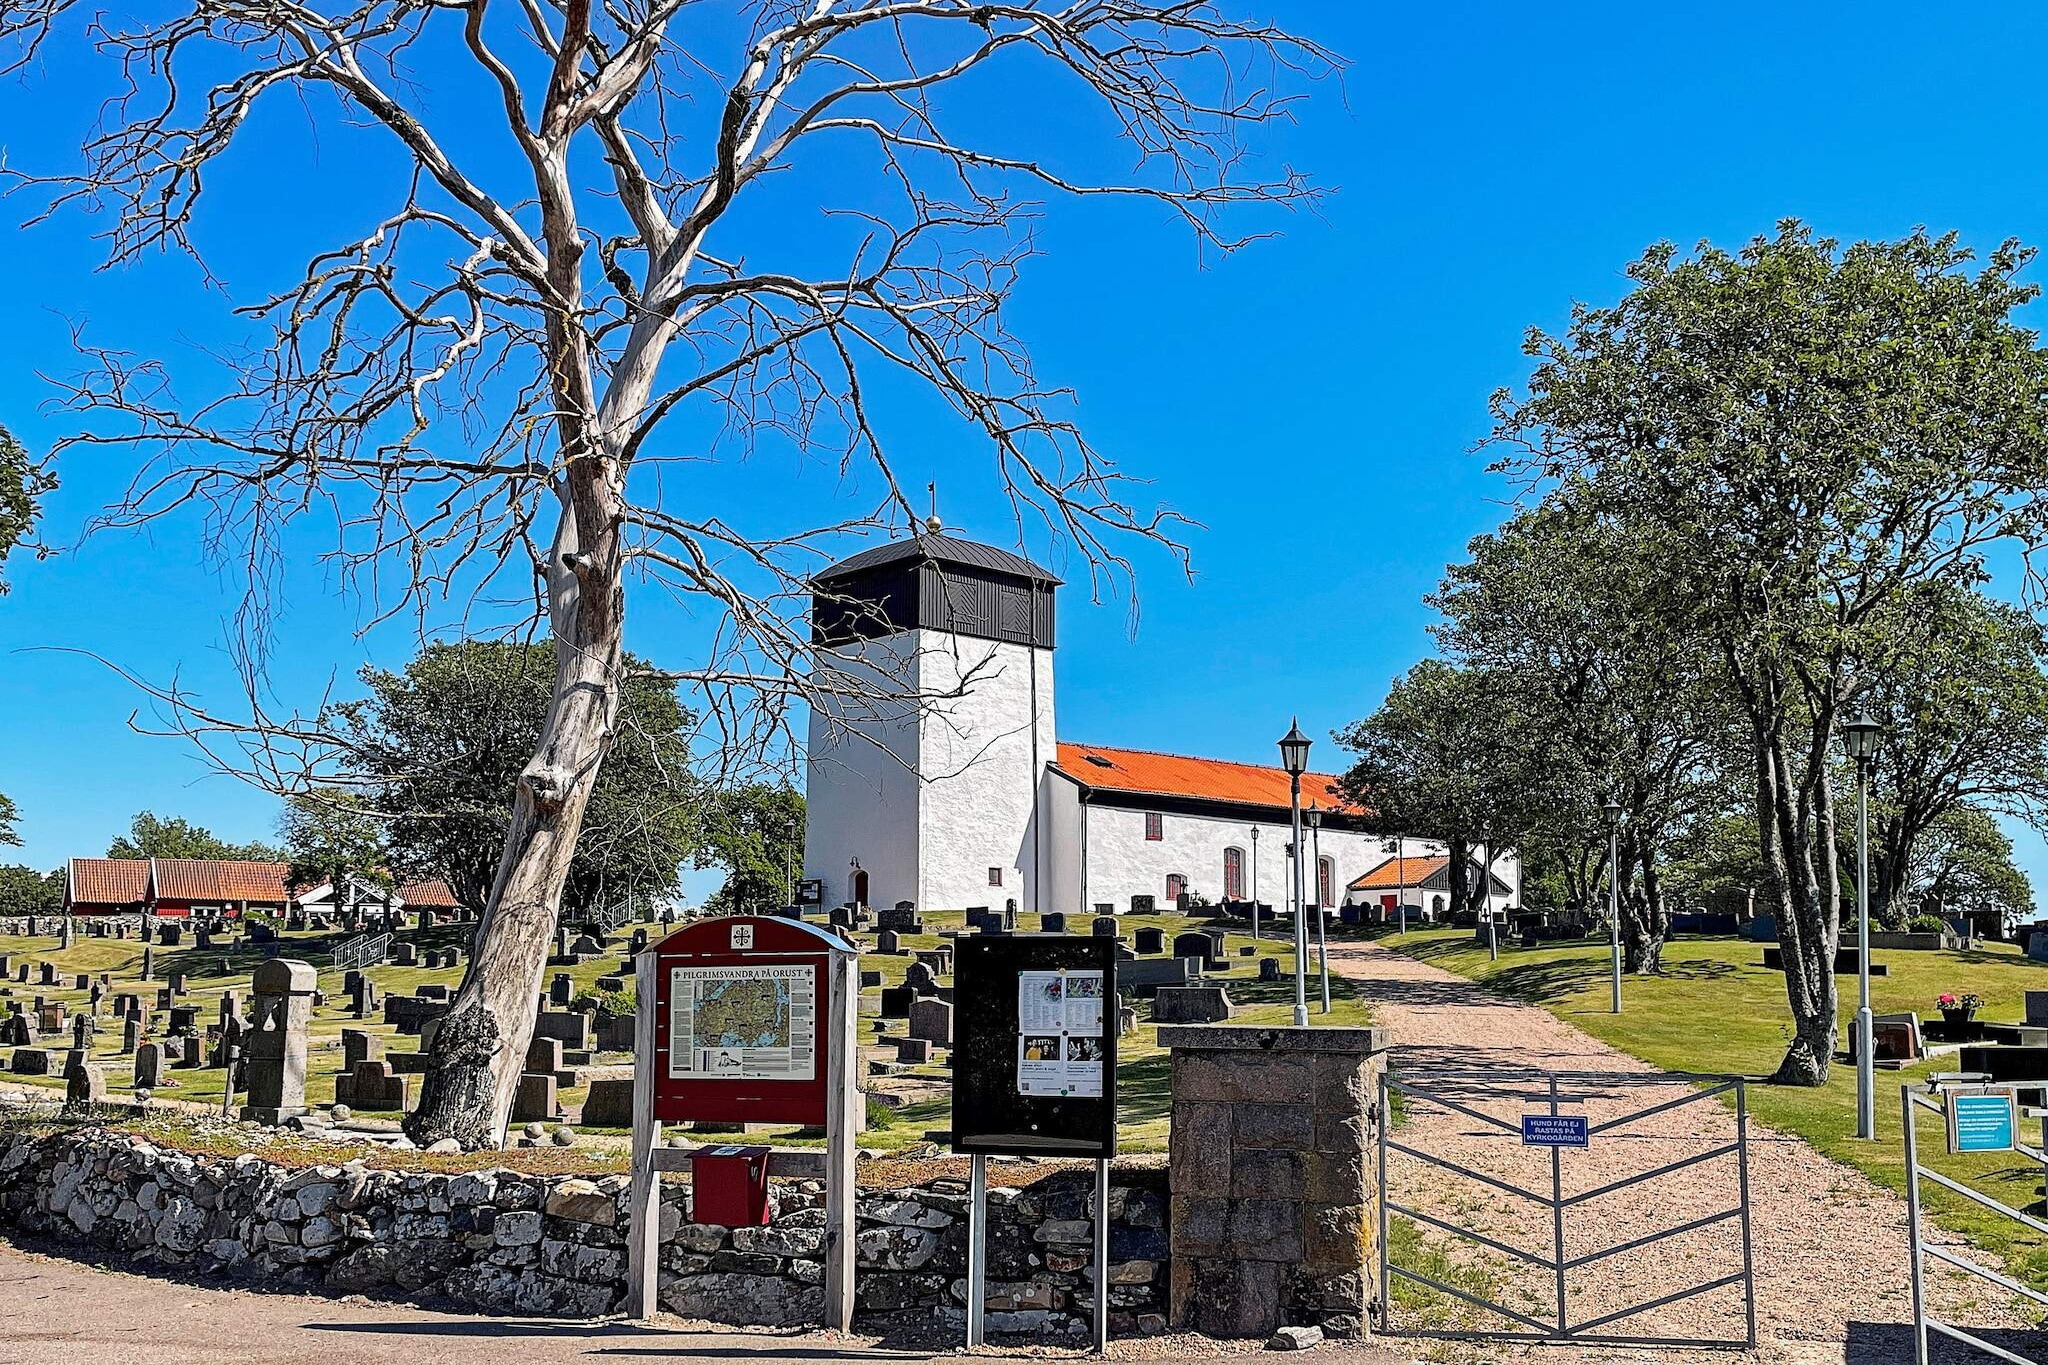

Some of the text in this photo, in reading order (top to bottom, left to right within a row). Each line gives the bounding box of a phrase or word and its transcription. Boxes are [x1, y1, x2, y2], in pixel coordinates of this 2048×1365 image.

[683, 968, 803, 979] PILGRIMSVANDRA PÅ ORUST
